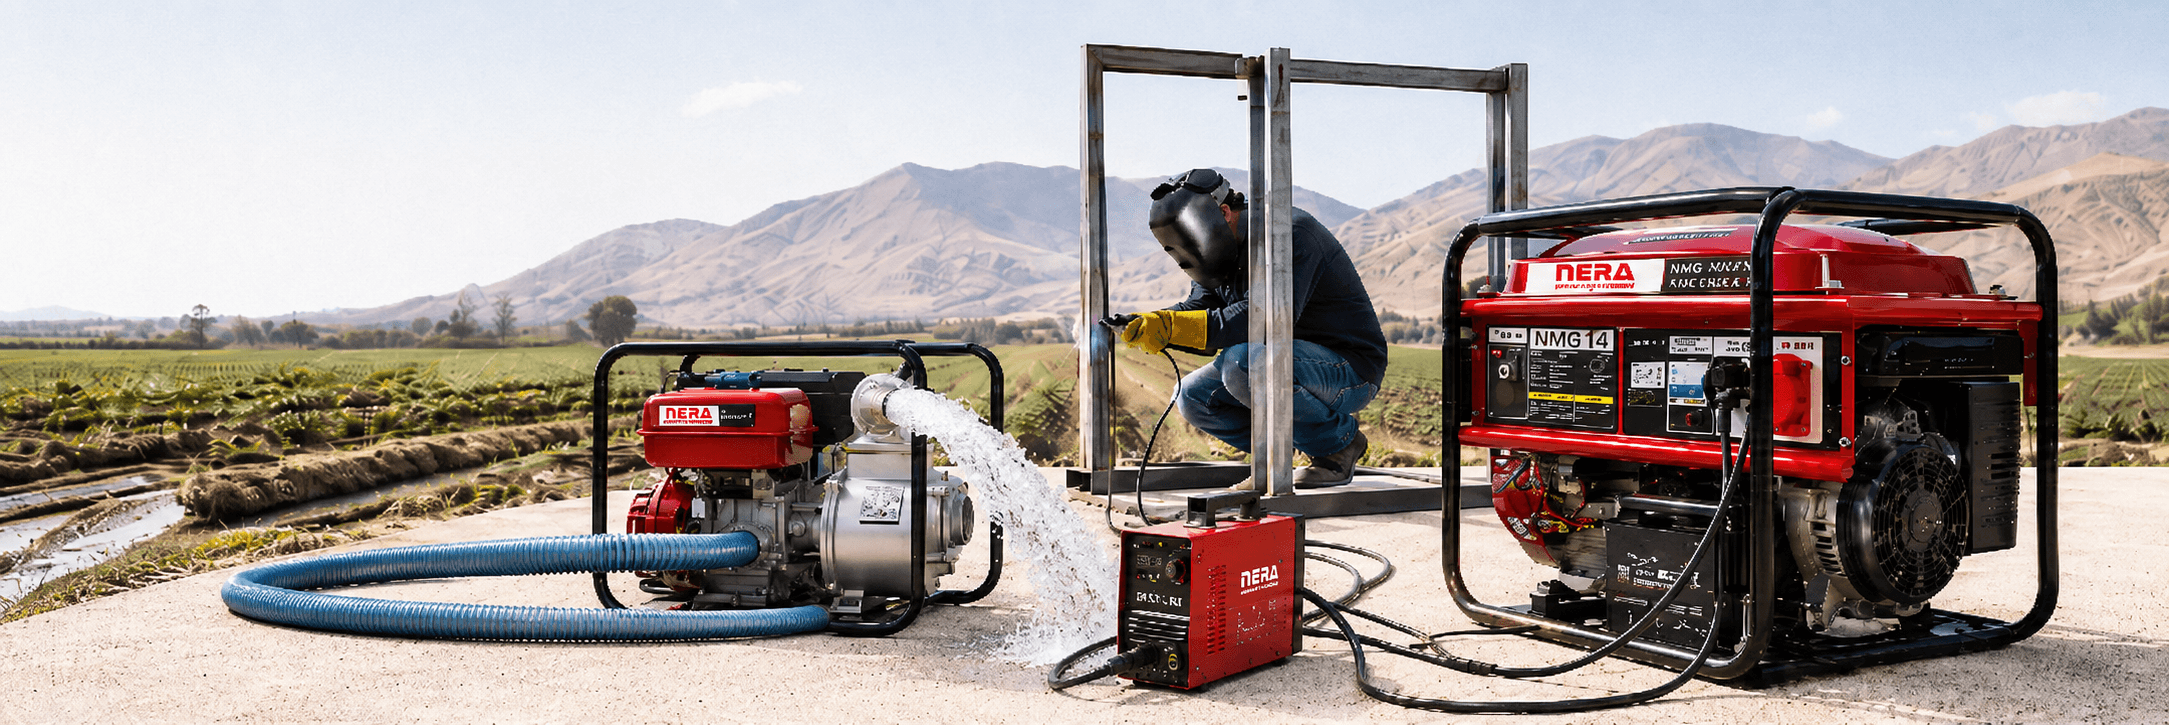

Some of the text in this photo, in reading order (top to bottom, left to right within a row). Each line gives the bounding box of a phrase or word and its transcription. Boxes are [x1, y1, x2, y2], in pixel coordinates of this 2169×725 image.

[1555, 262, 1635, 282] NERA
[1669, 262, 1703, 274] NMG
[1534, 330, 1581, 348] NMG
[1585, 330, 1608, 349] 14
[665, 407, 712, 420] NERA
[1240, 564, 1279, 588] NERA
